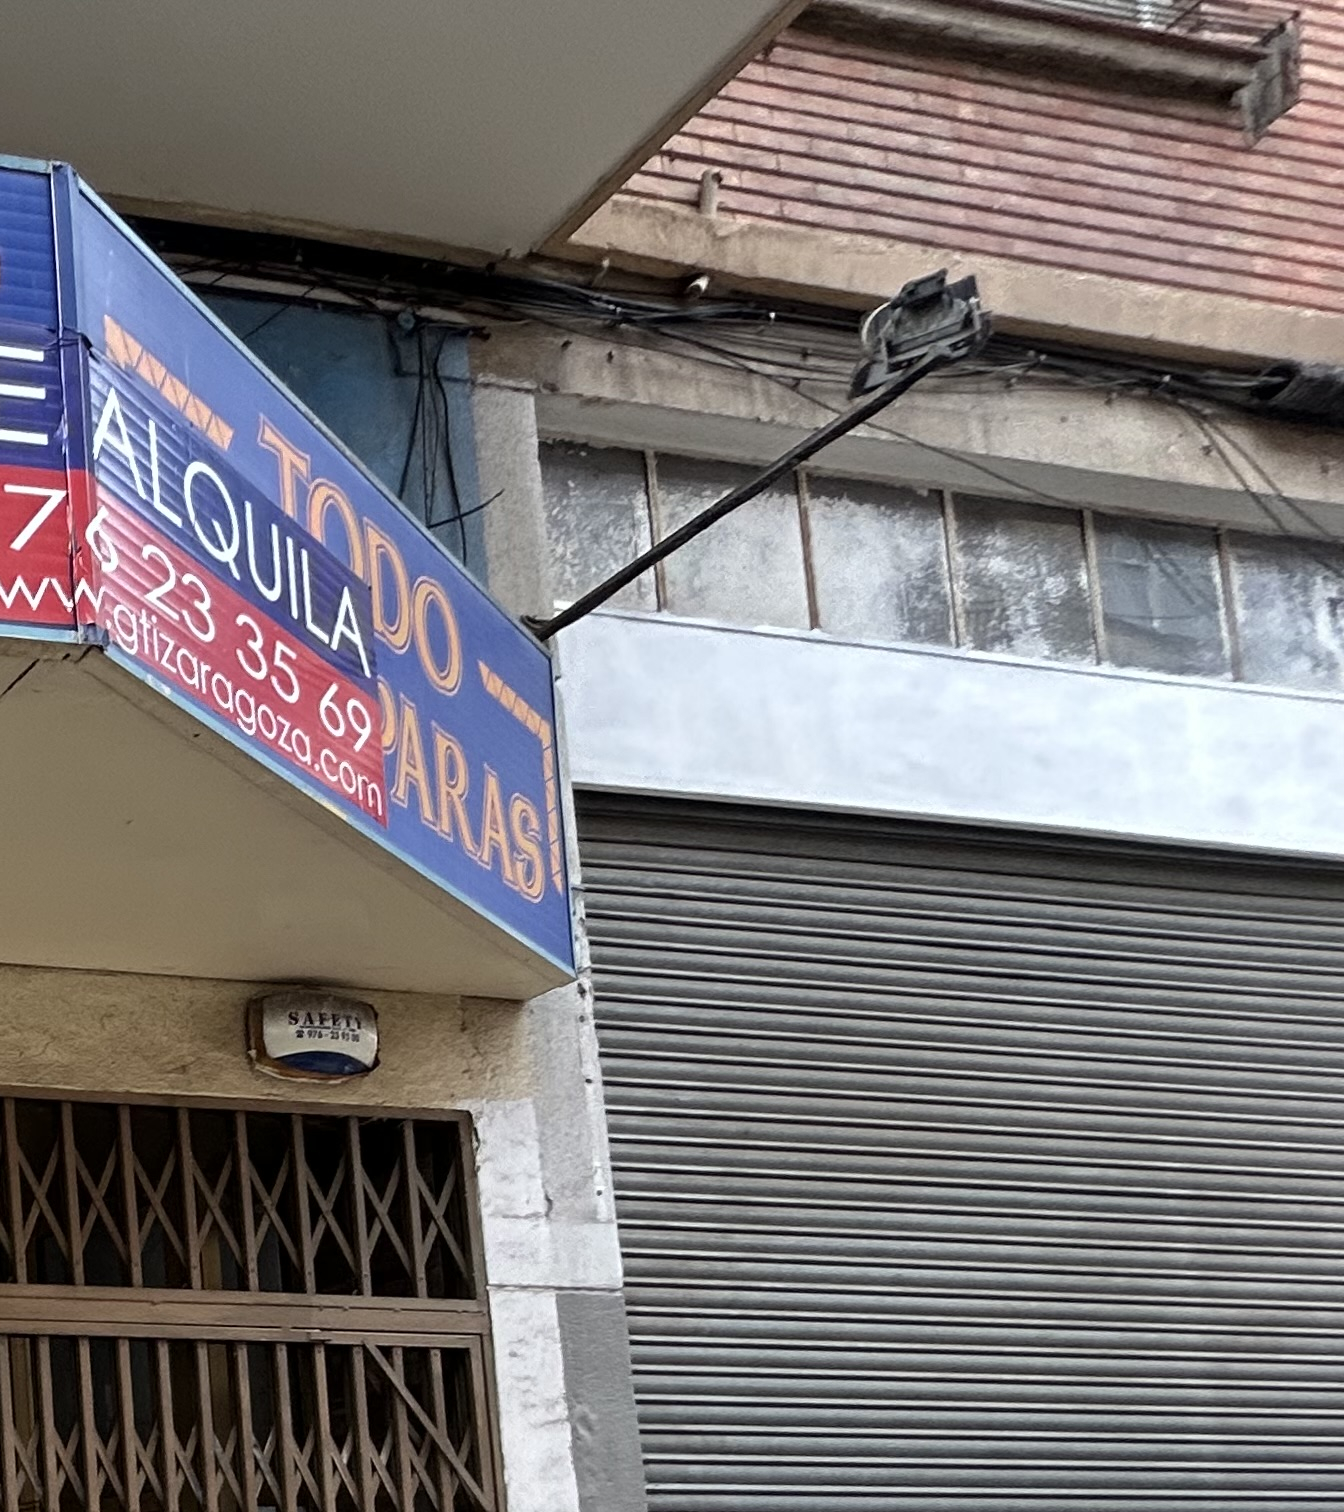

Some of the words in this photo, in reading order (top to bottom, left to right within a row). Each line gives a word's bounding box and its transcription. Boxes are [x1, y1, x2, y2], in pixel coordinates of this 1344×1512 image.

[93, 387, 372, 677] ALQUILA
[142, 544, 216, 642] 23
[235, 614, 300, 704] 35
[319, 683, 372, 752] 69
[257, 413, 463, 696] TODO
